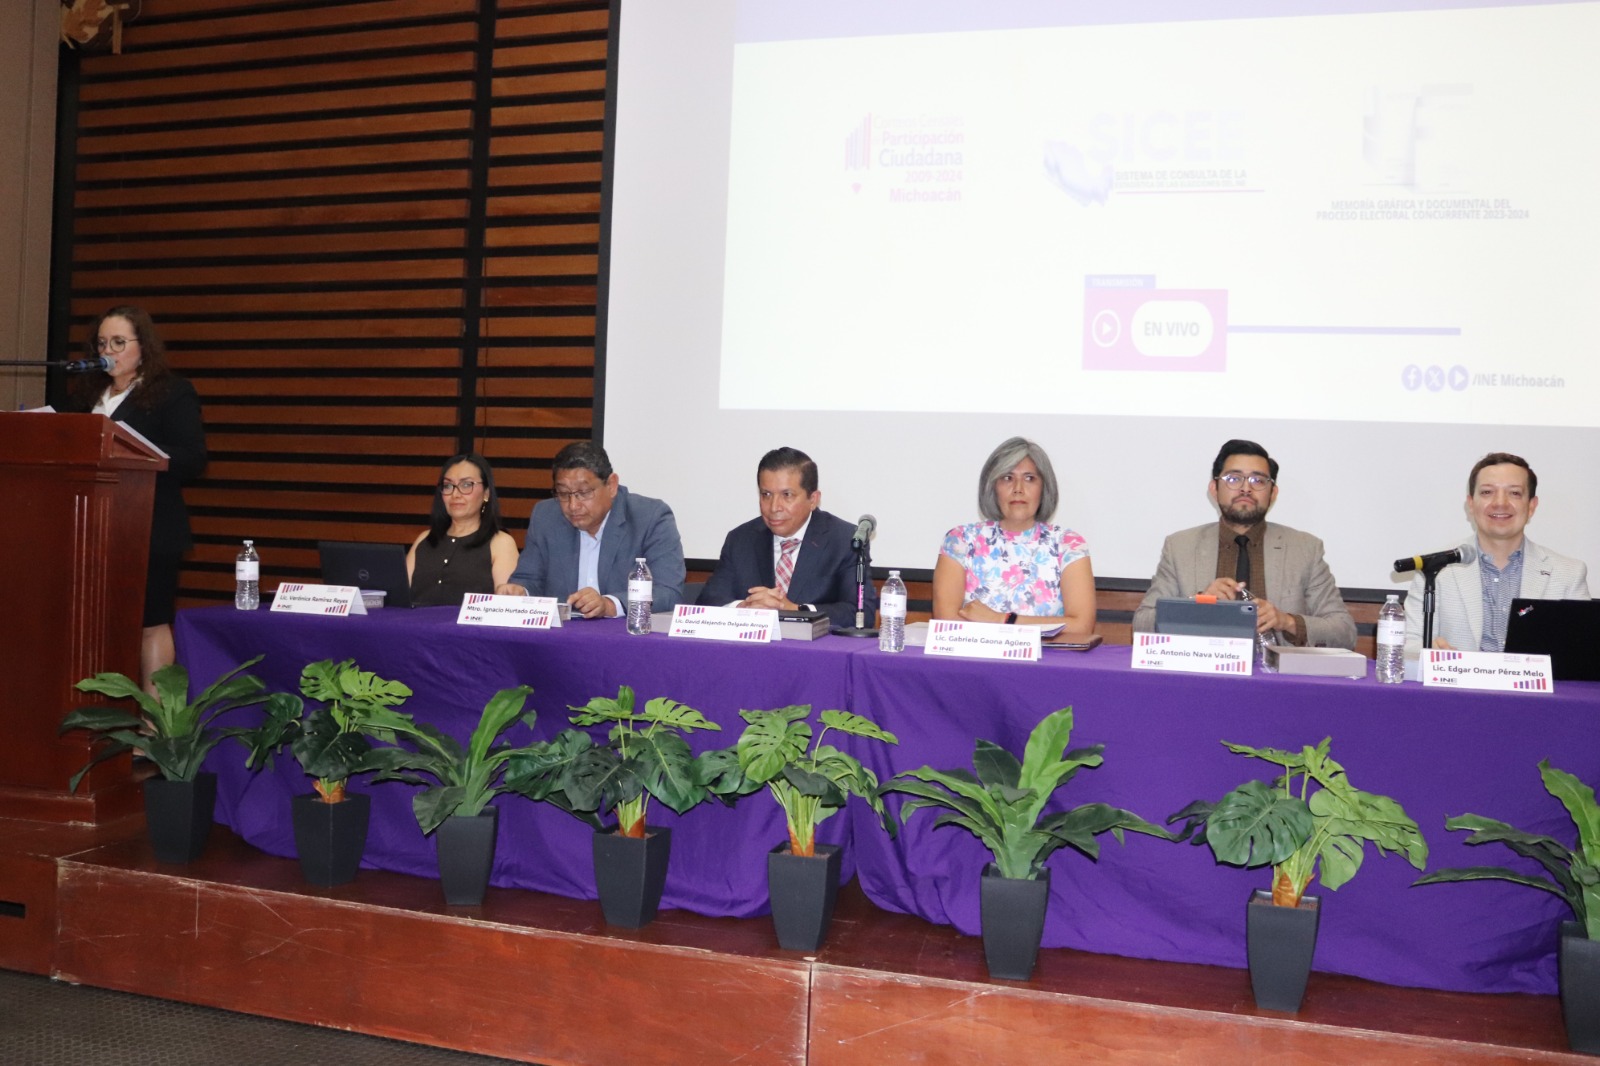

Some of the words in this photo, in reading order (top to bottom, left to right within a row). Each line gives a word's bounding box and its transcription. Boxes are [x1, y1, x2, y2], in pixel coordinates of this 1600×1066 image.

[882, 128, 965, 148] Participación
[1088, 111, 1247, 163] SICEE
[879, 147, 964, 167] Ciudadana
[1115, 171, 1154, 180] SISTEMA
[1155, 171, 1168, 180] DE
[1170, 170, 1218, 179] CONSULTA
[1220, 169, 1232, 178] DE
[1235, 169, 1248, 178] LA
[889, 187, 962, 203] Michoacán
[1377, 197, 1416, 209] GRÁFICA
[1417, 199, 1424, 209] Y
[1426, 198, 1491, 209] DOCUMENTAL
[1493, 198, 1511, 209] DEL
[1317, 210, 1358, 221] PROCESO
[1360, 210, 1410, 220] ELECTORAL
[1412, 209, 1482, 220] CONCURRENTE
[1483, 209, 1530, 220] 2023-2024
[1144, 321, 1162, 336] EN
[1166, 321, 1200, 337] VIVO
[1472, 373, 1497, 386] /INE
[1500, 374, 1565, 388] Michoacán
[949, 635, 978, 643] Gabriela
[980, 637, 1003, 645] Gaona
[1004, 639, 1031, 647] Agüero
[1160, 649, 1191, 657] Antonio
[1214, 652, 1240, 660] Valdez
[1448, 665, 1472, 674] Edgar
[1498, 667, 1521, 676] Pérez
